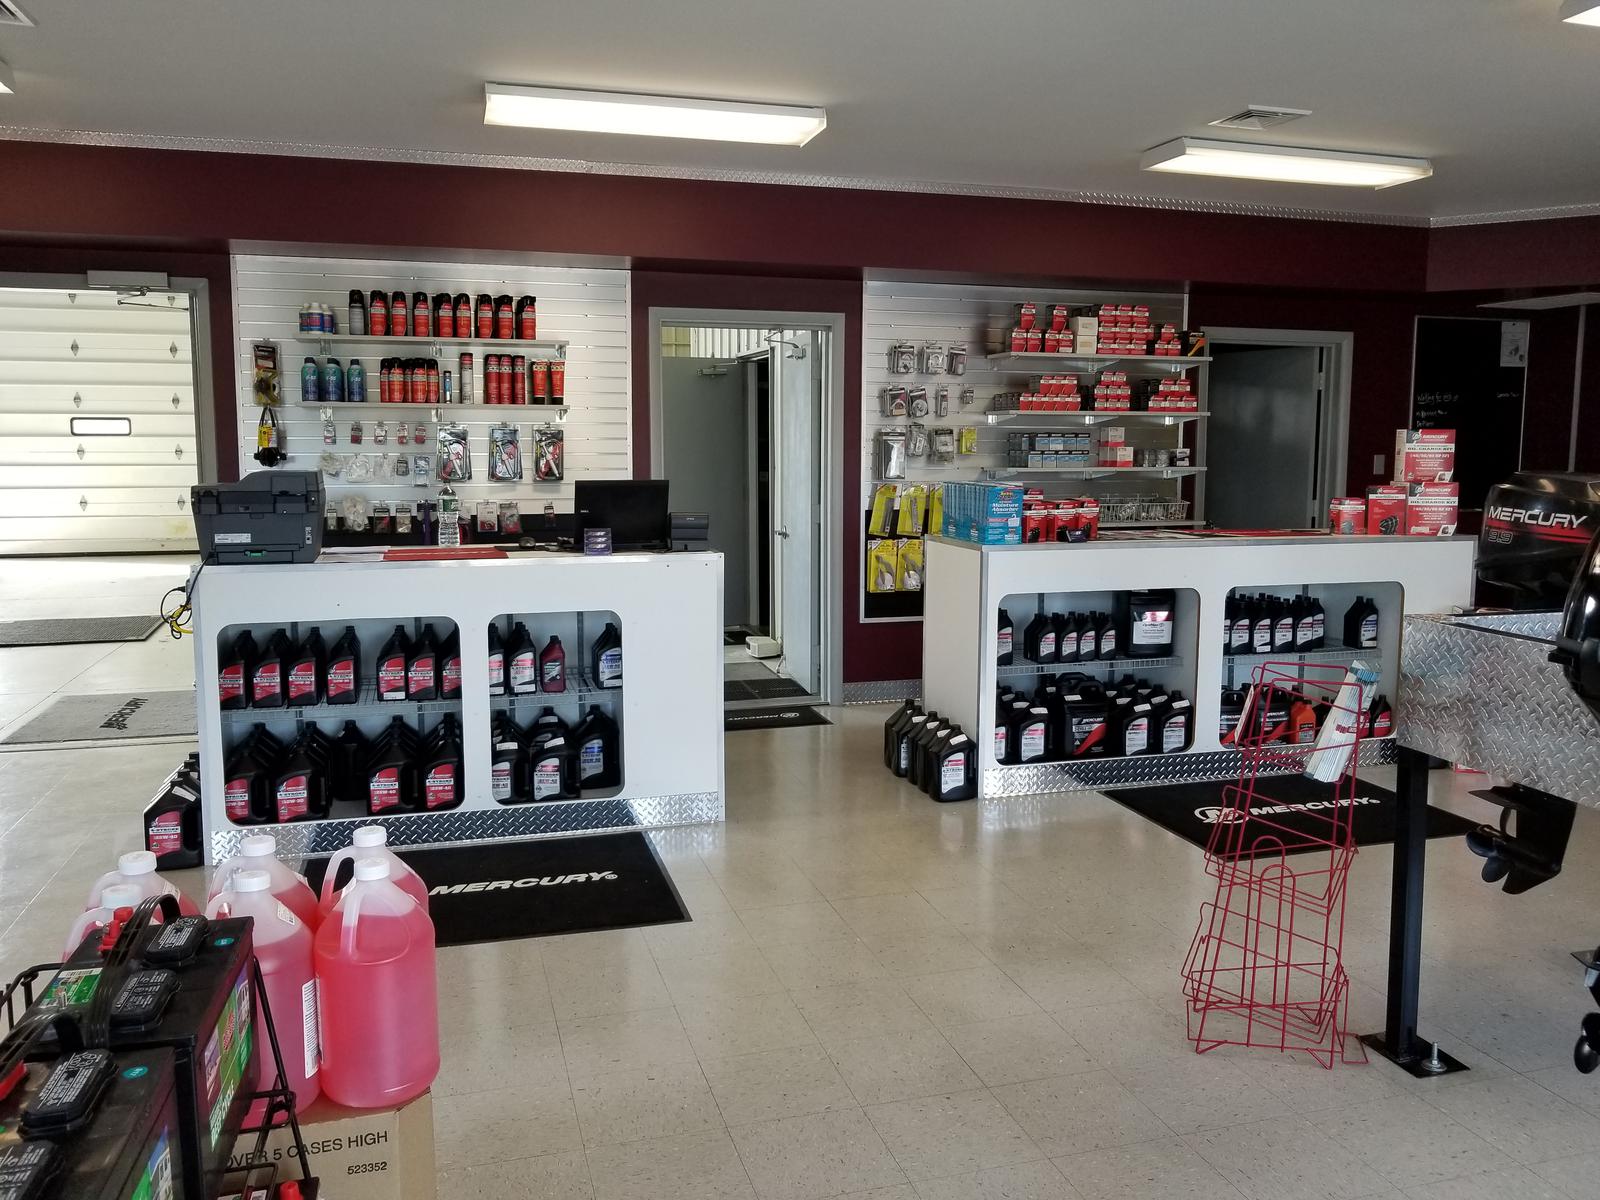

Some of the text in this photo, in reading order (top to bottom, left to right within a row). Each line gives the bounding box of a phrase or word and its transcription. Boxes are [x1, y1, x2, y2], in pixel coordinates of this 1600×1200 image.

[1488, 505, 1588, 529] MERCURY
[1488, 529, 1514, 545] 9.9
[1250, 797, 1370, 816] MERCURY
[428, 870, 615, 896] MERCURY
[273, 1148, 283, 1161] 5
[287, 1138, 343, 1158] CASES
[348, 1130, 388, 1148] HIGH
[347, 1161, 388, 1175] 523352
